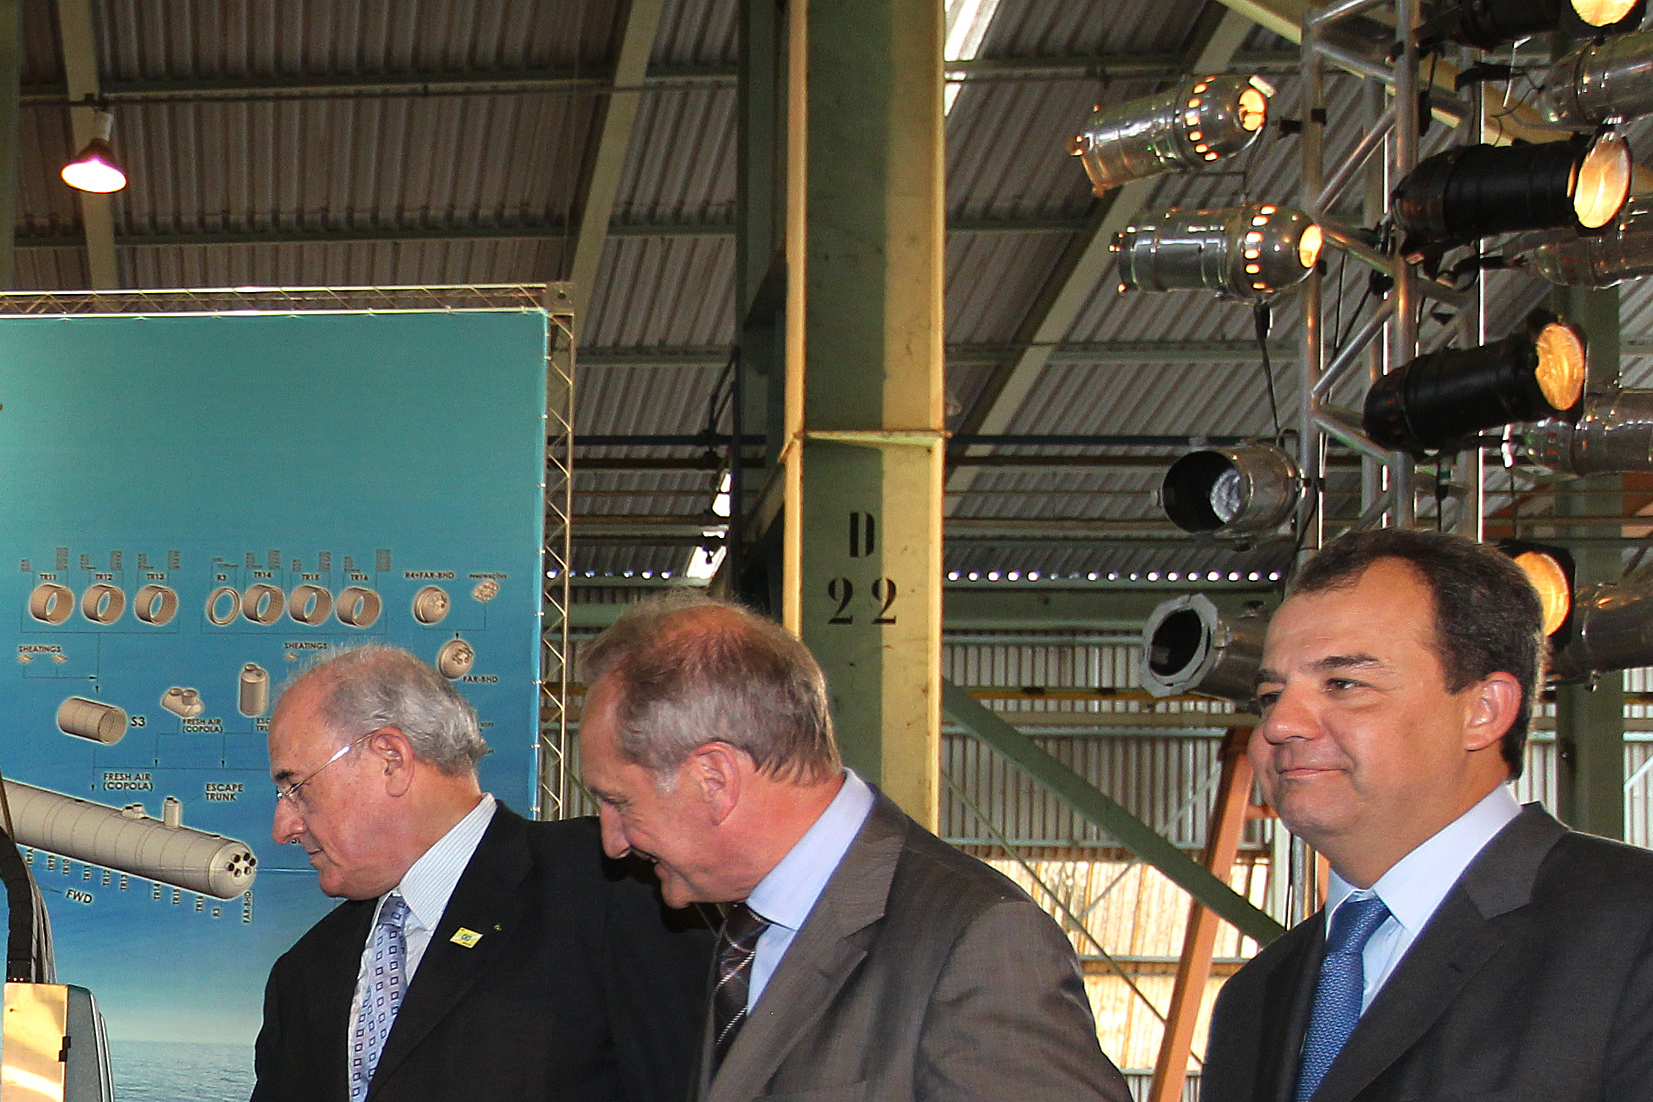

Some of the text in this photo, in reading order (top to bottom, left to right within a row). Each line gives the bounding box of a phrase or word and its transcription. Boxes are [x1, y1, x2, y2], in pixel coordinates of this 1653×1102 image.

[850, 512, 875, 558] D
[131, 716, 146, 727] S3
[103, 773, 151, 781] FRESH AIR
[103, 781, 154, 792] (COPOLA)
[66, 889, 93, 904] FWD
